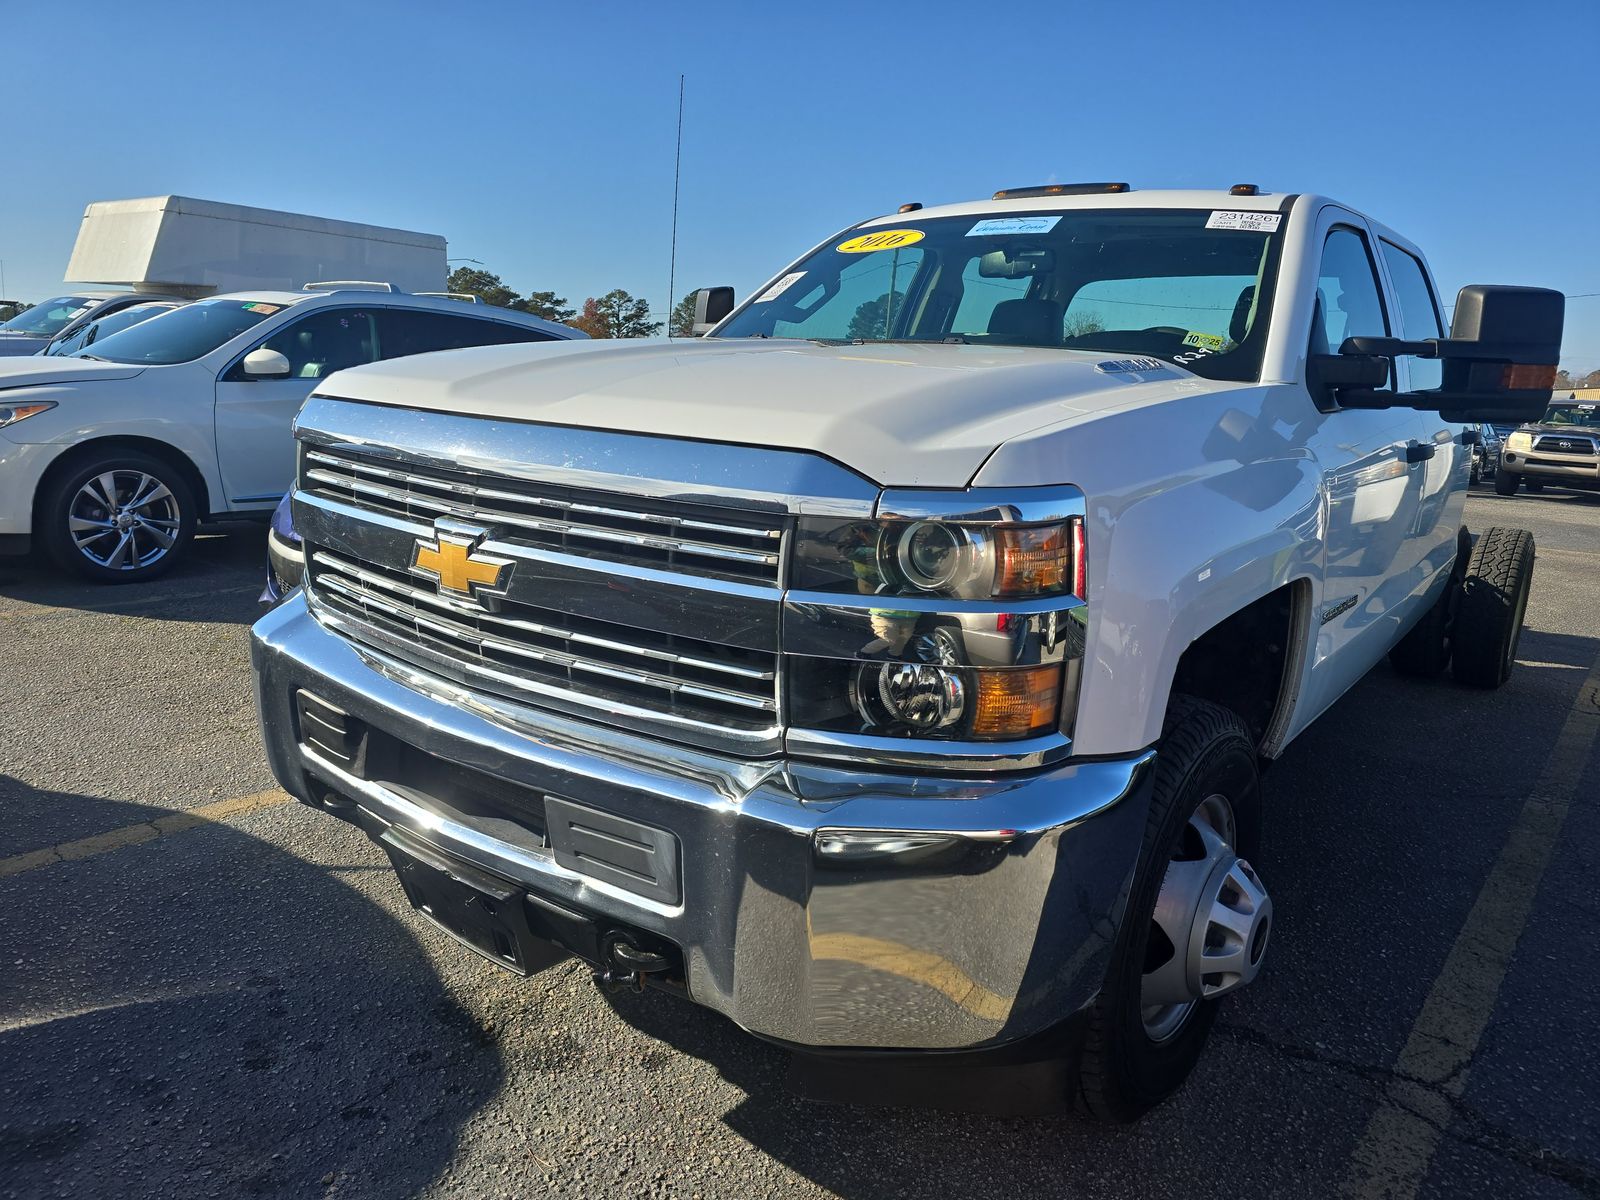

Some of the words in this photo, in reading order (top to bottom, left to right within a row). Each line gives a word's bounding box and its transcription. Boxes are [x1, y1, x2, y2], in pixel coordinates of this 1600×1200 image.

[1219, 213, 1279, 222] 2314261
[845, 233, 915, 250] 2016
[1187, 334, 1200, 344] 10
[1209, 338, 1221, 347] 25
